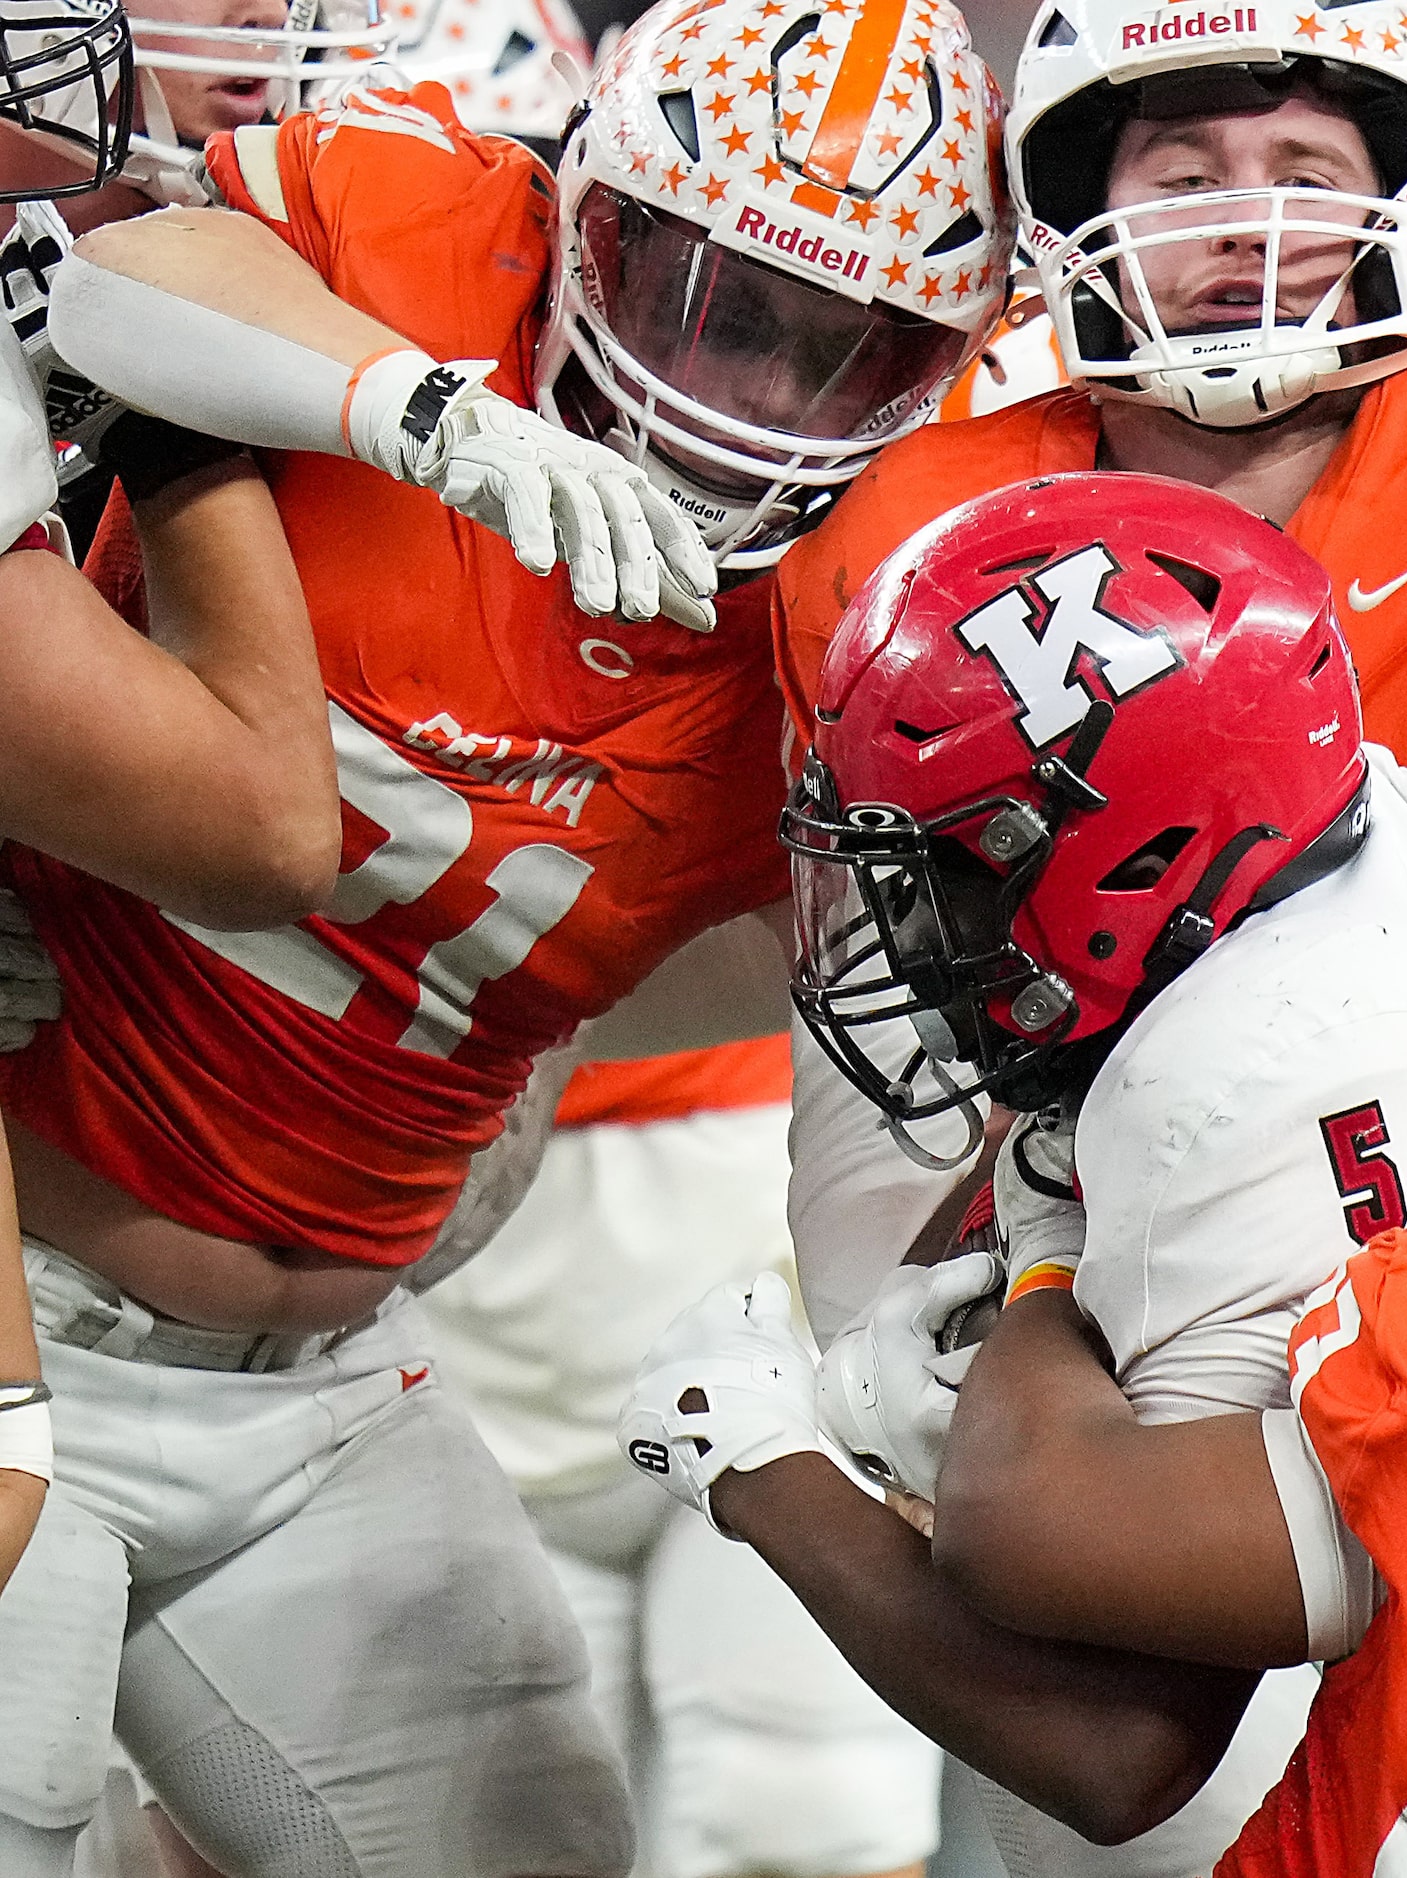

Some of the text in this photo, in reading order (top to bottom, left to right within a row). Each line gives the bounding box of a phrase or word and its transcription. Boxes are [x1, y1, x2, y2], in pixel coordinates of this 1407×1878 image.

[1122, 9, 1256, 50] Riddell
[735, 205, 870, 282] Riddell
[400, 366, 467, 444] NIKE
[669, 488, 726, 522] Riddell
[954, 541, 1186, 750] K
[402, 711, 605, 828] CELINA
[1319, 1099, 1407, 1247] 5
